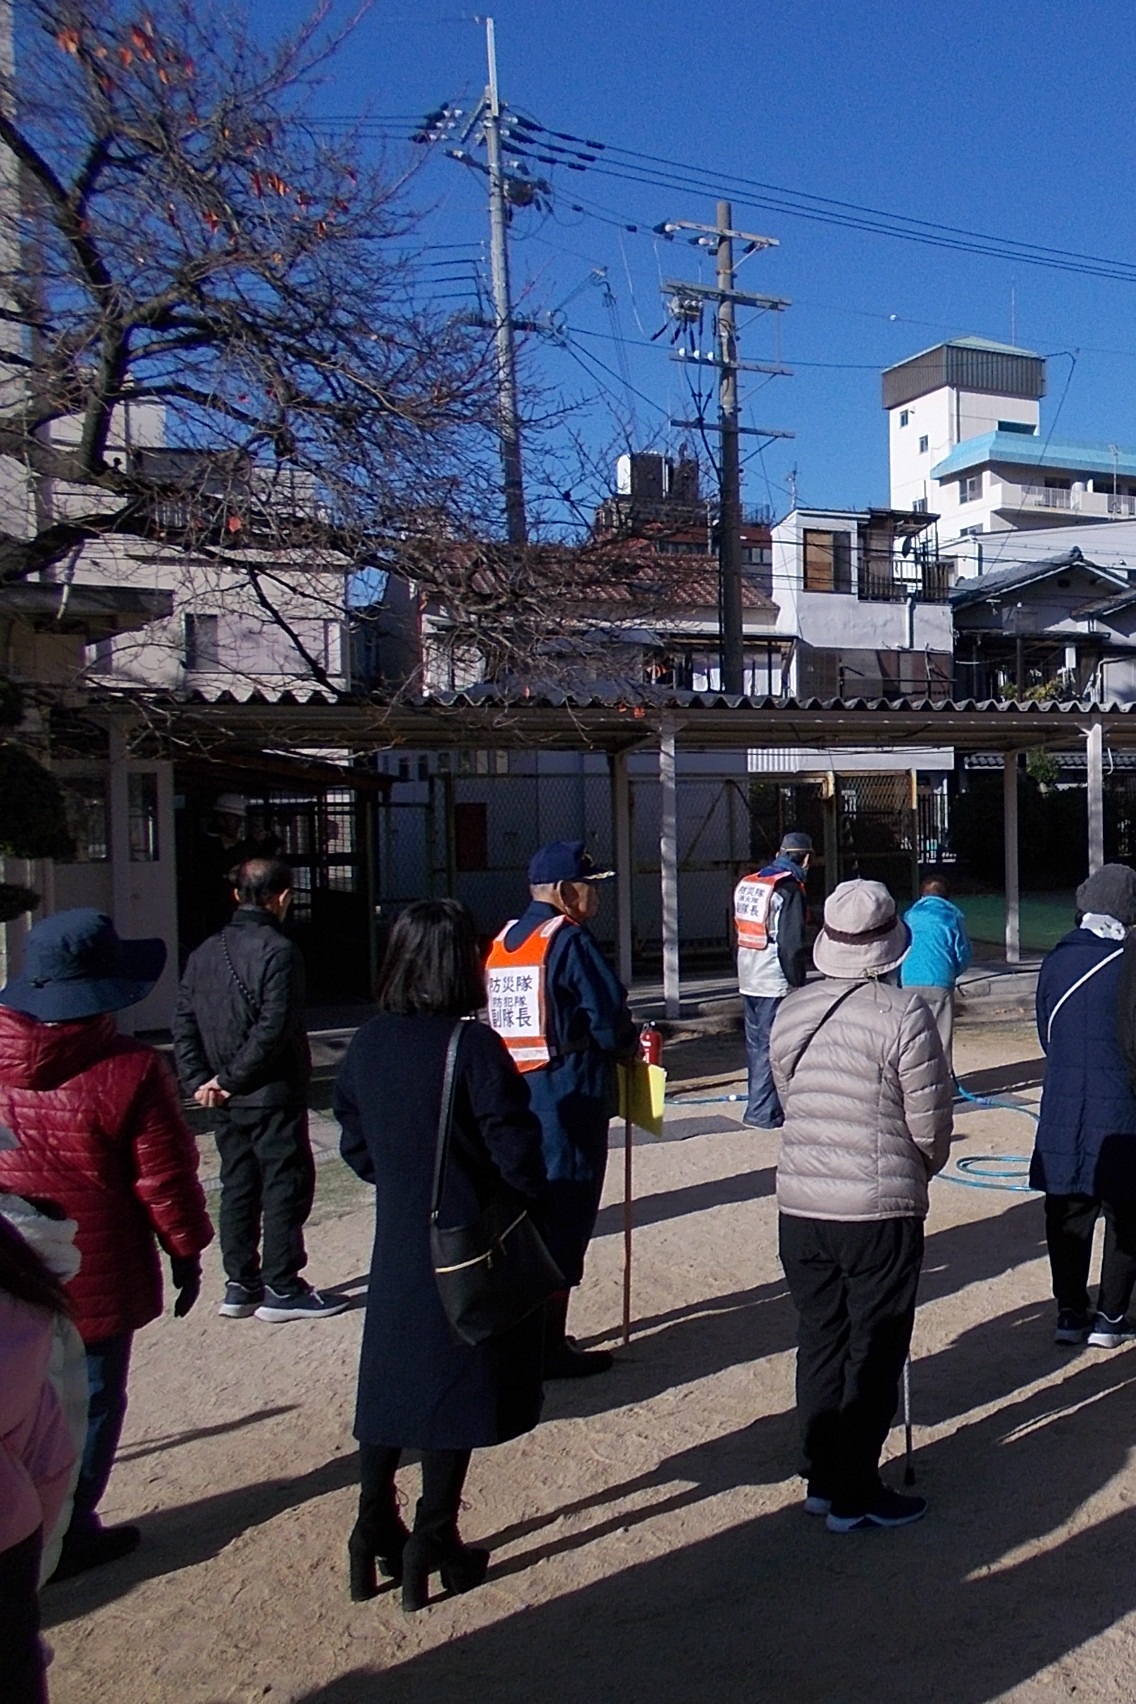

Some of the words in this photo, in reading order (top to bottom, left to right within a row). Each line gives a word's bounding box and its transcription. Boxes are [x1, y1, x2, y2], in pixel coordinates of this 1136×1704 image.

[489, 975, 533, 993] 防災隊
[492, 995, 527, 1007] 防犯隊
[491, 1007, 532, 1028] 副隊長
